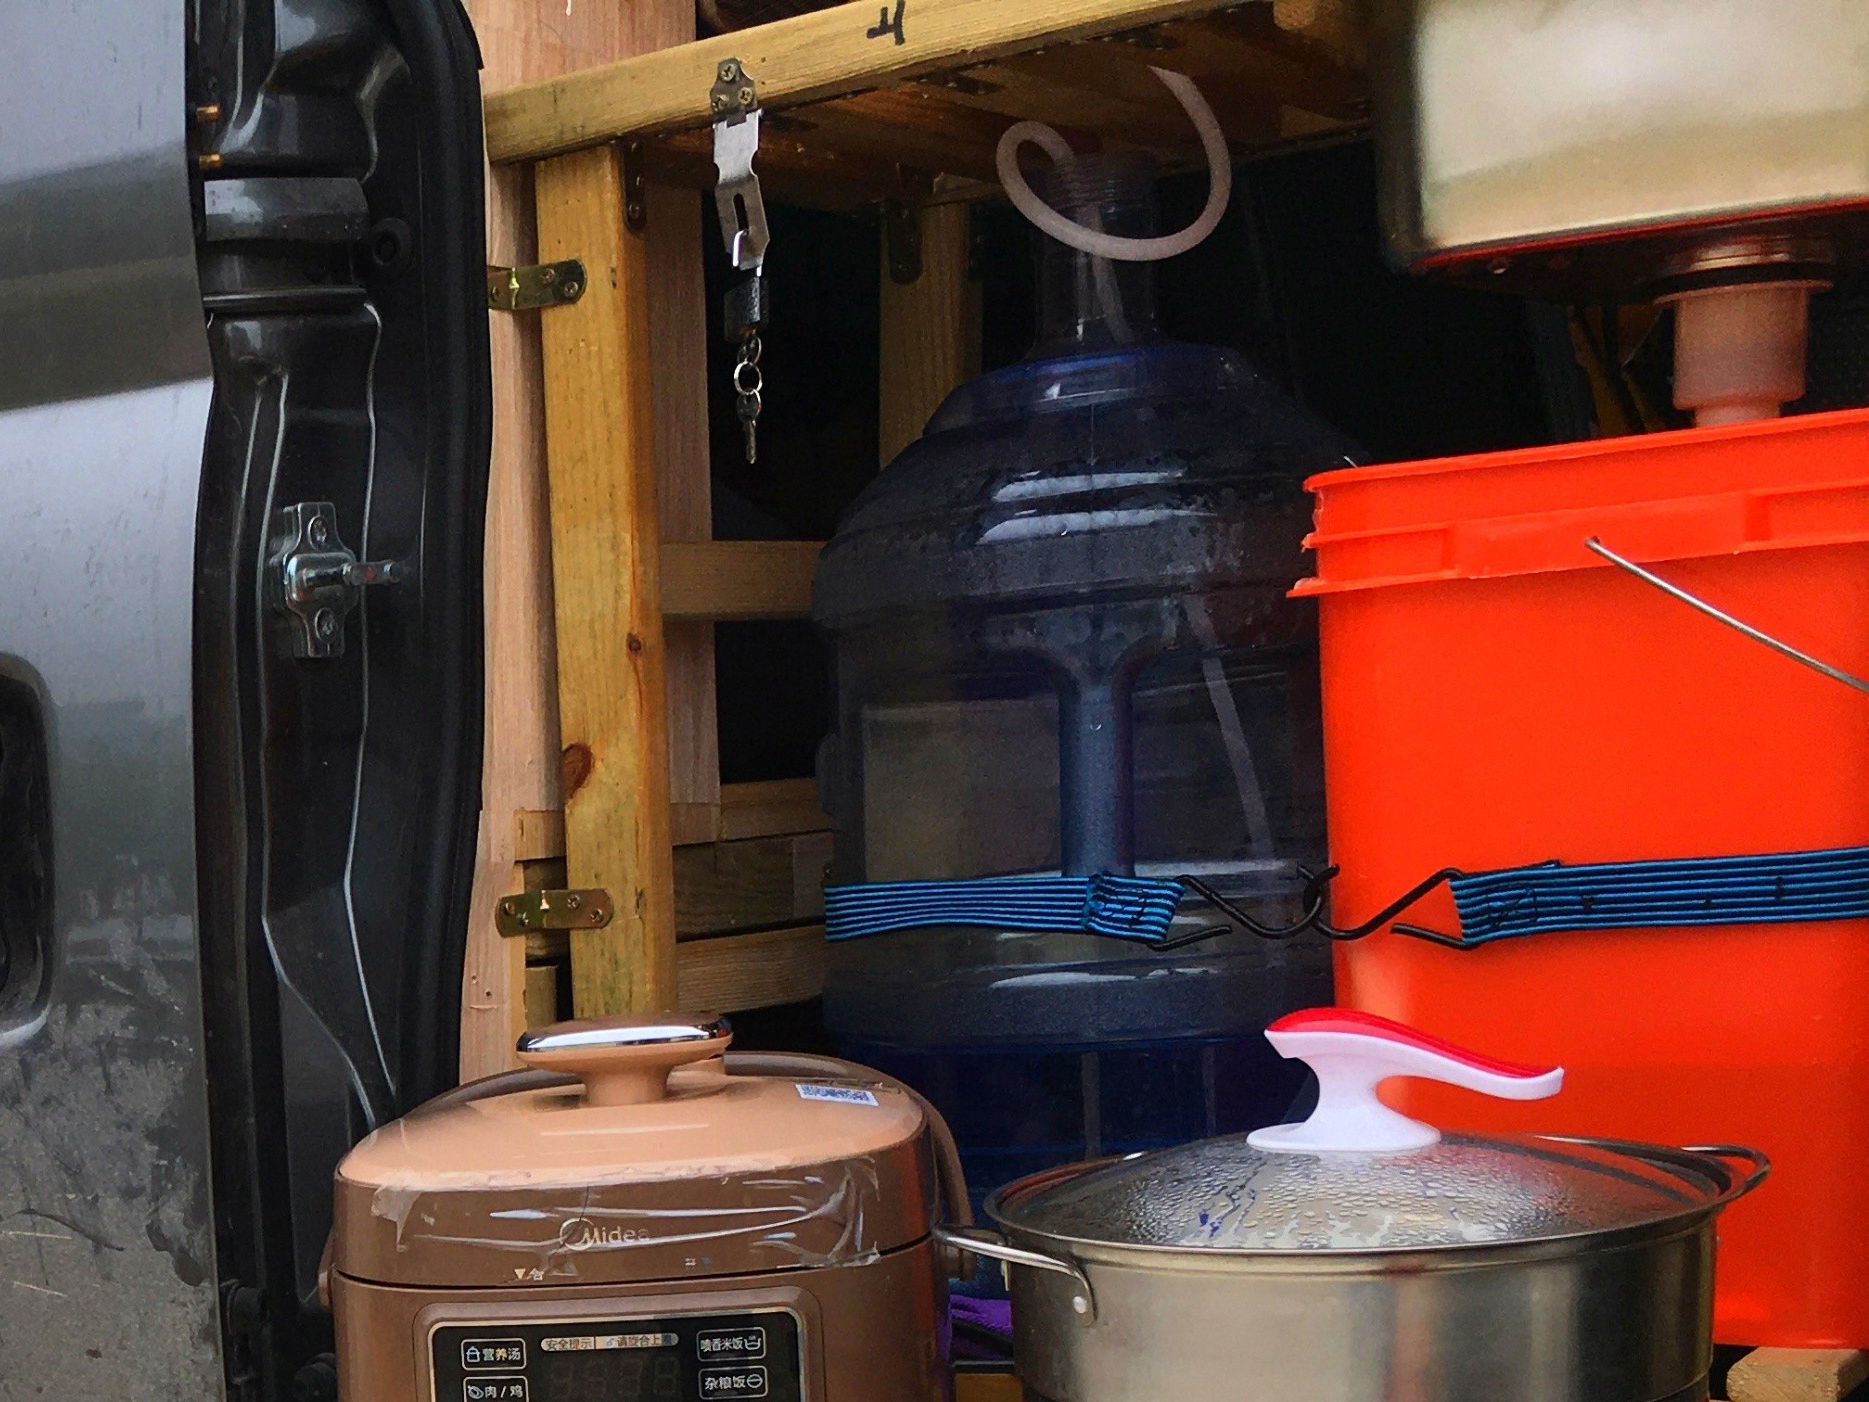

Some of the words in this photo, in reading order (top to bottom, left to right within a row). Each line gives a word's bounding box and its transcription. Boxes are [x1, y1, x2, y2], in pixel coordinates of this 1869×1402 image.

[482, 1346, 521, 1361] 营养汤
[704, 1375, 746, 1390] 杂粮饭
